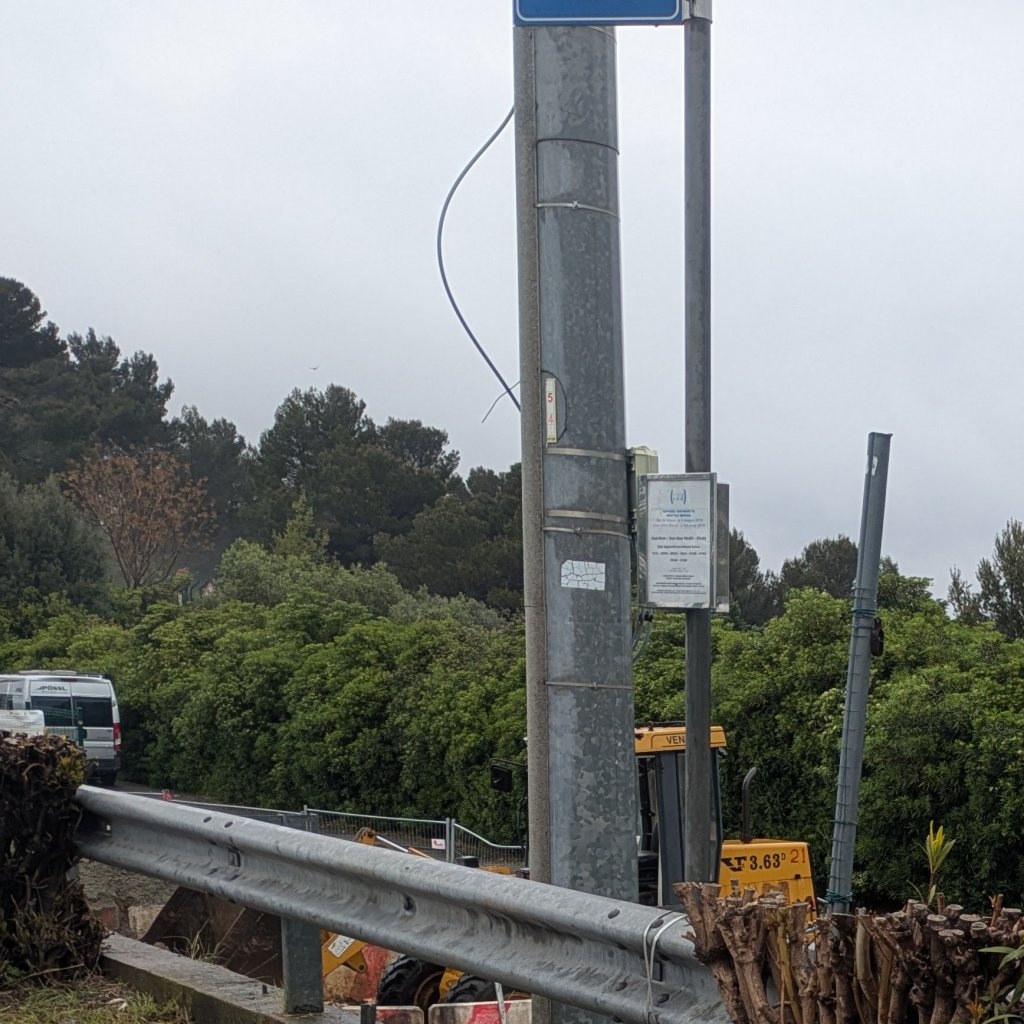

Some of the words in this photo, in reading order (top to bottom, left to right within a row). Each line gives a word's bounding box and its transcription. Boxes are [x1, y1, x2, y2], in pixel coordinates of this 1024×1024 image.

[547, 392, 553, 403] 5
[666, 735, 686, 745] VEN
[789, 847, 806, 864] 21
